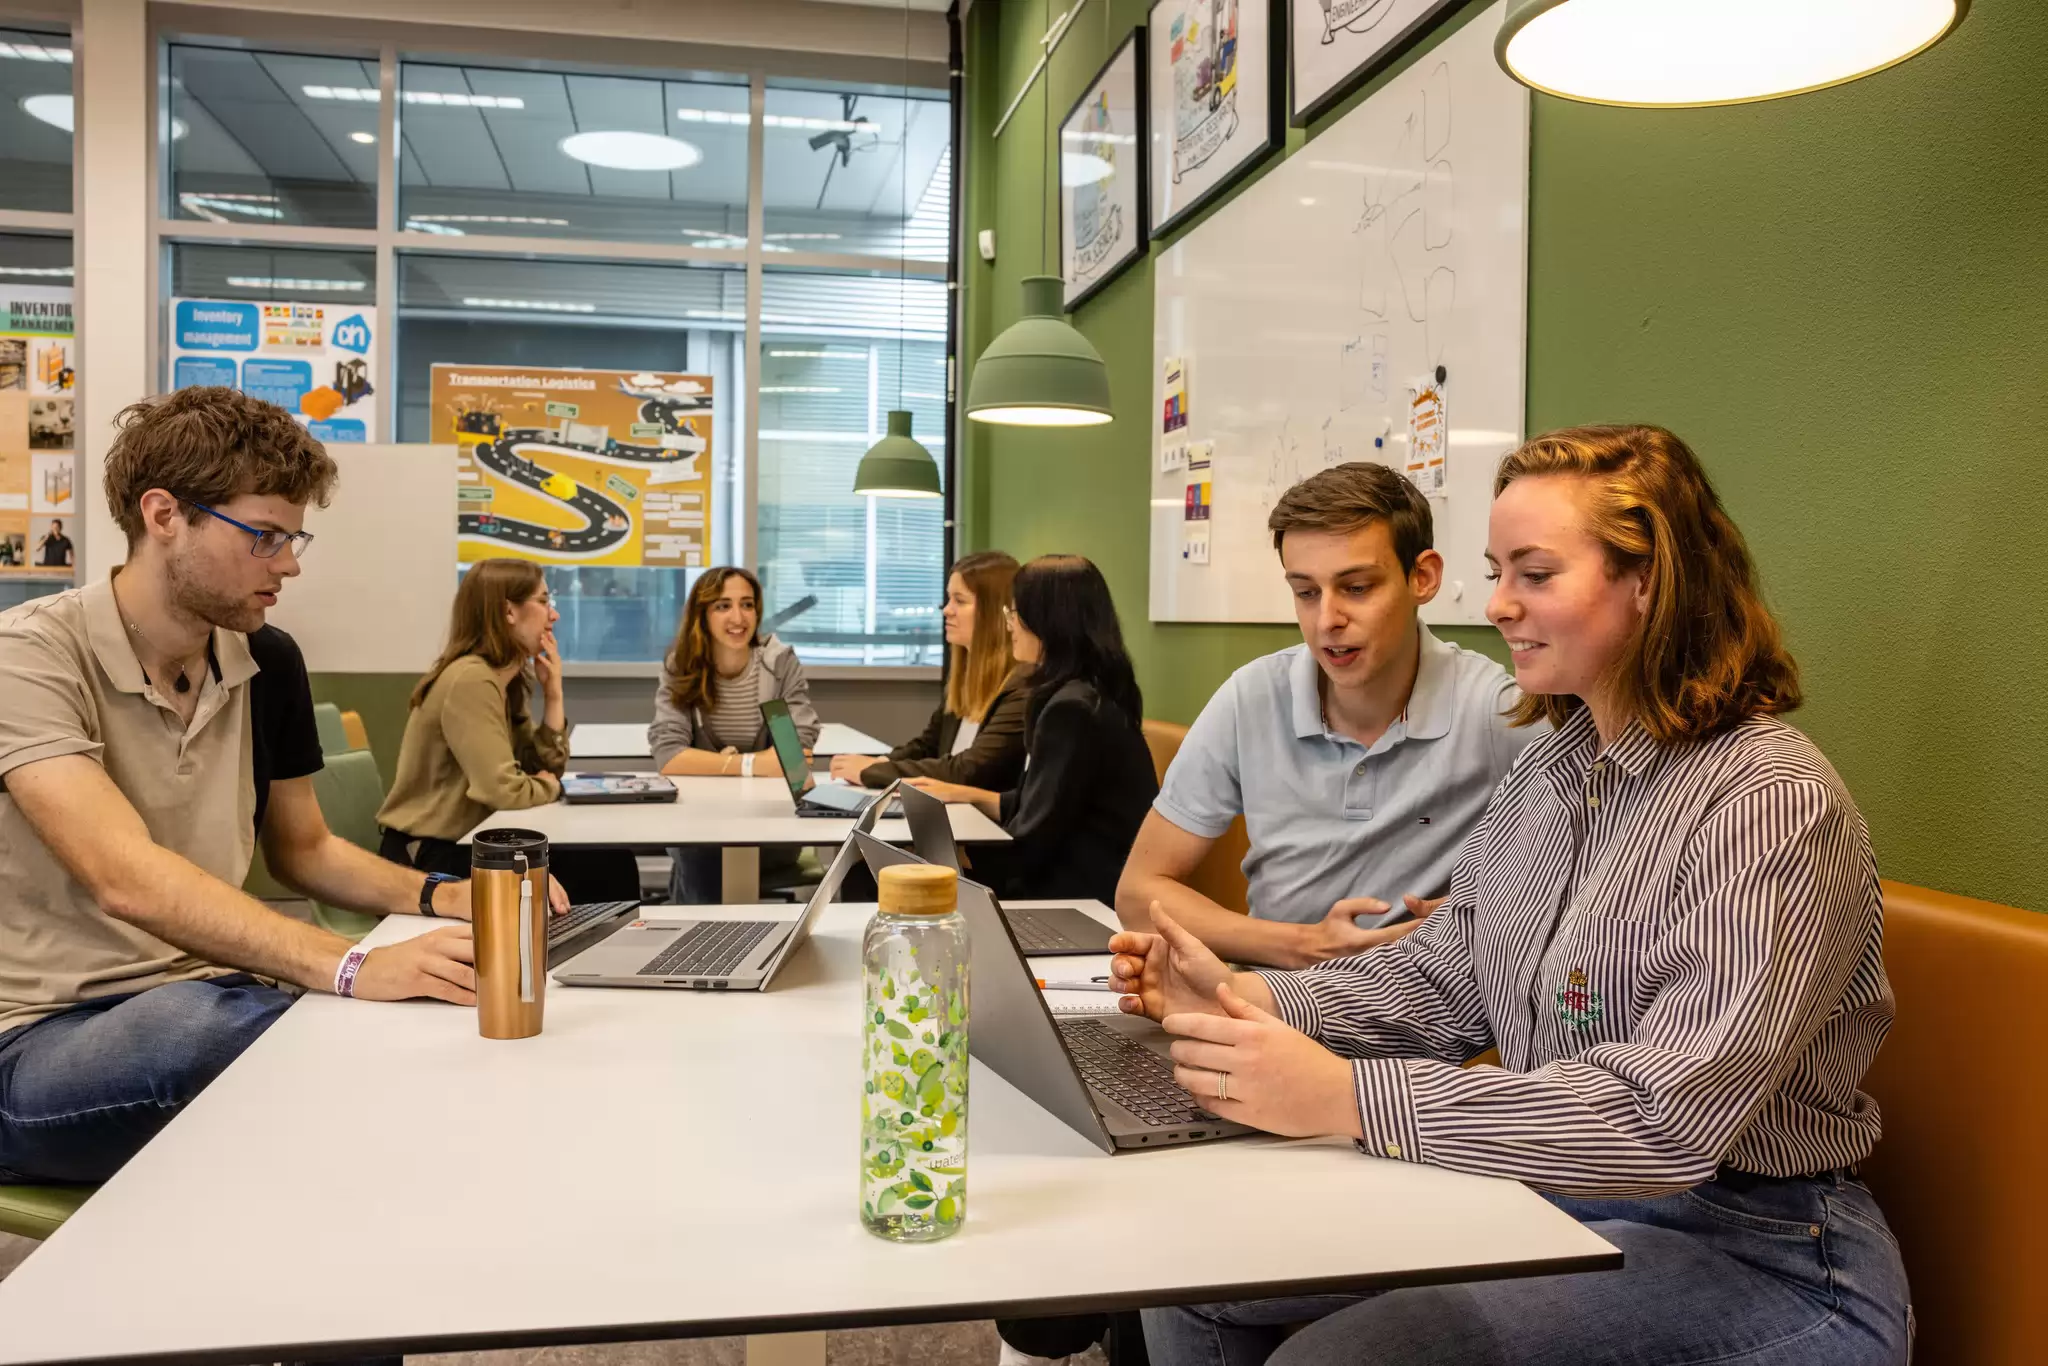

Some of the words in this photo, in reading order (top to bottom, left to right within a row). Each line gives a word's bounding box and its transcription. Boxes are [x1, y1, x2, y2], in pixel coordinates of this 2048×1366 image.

[193, 308, 244, 327] Inventory
[183, 332, 252, 347] management
[449, 373, 541, 388] Transportation
[542, 377, 596, 390] Logistics
